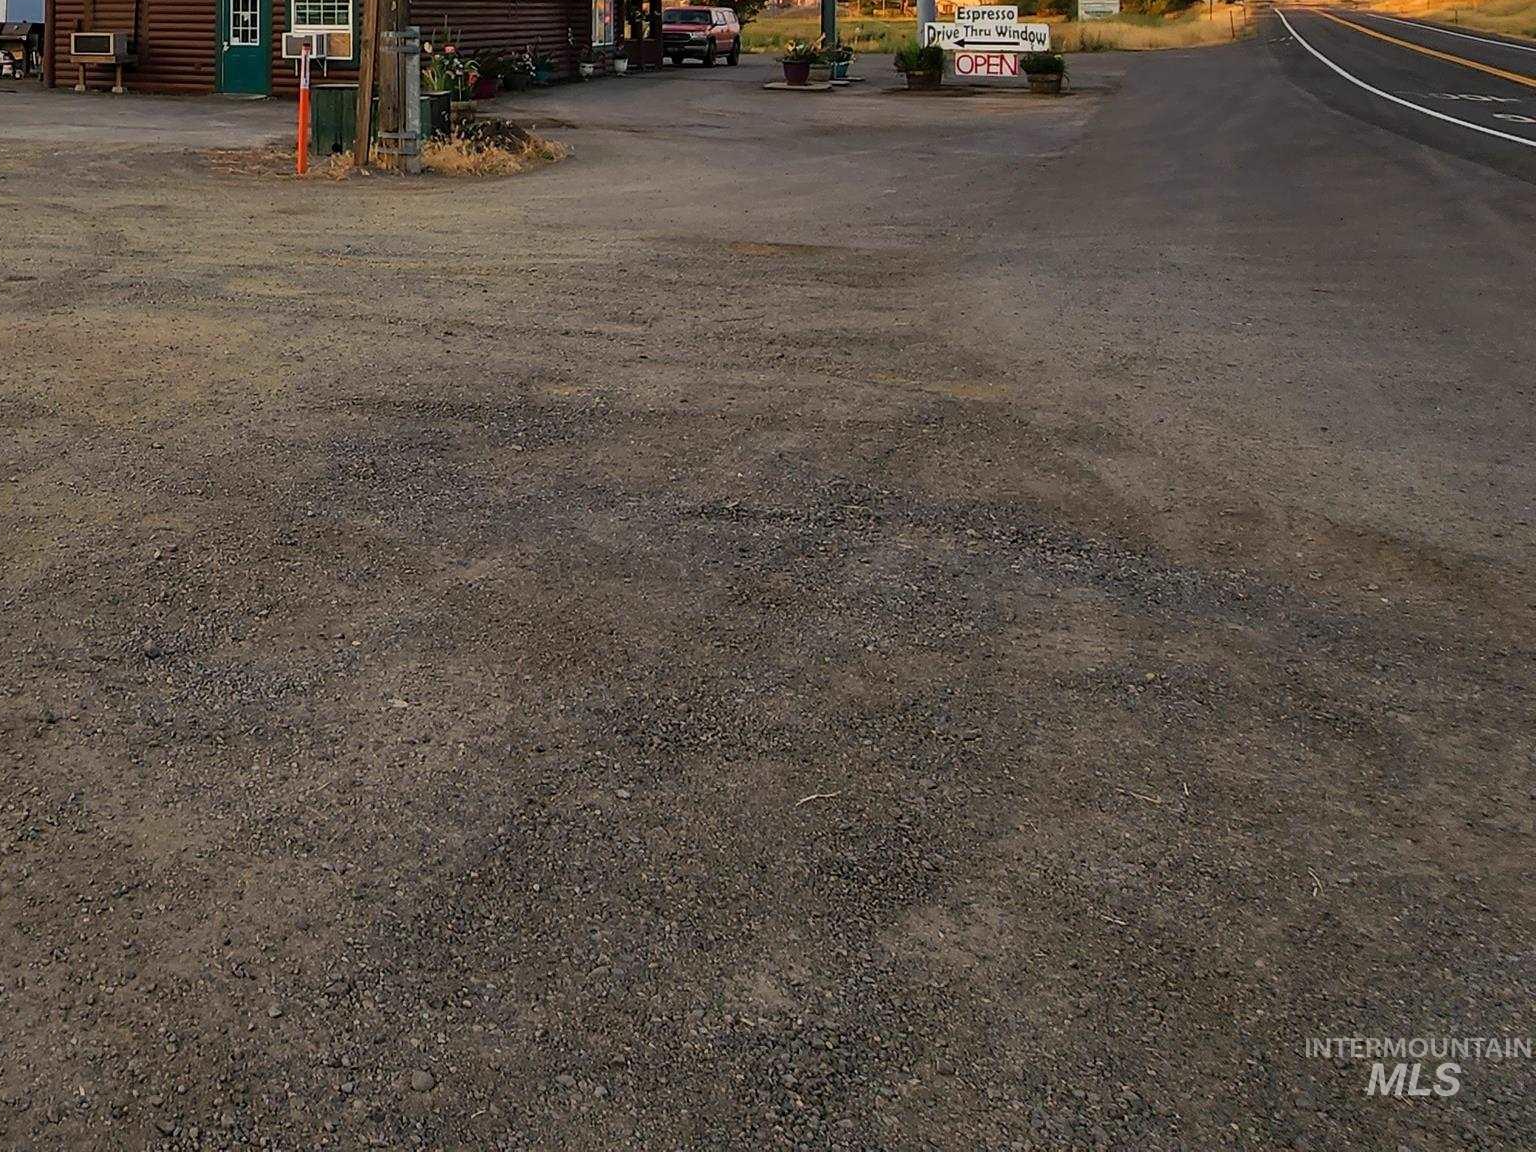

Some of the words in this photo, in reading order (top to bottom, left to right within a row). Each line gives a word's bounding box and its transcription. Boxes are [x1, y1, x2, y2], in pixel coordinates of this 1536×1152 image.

[957, 6, 1015, 22] Espresso
[927, 25, 960, 45] Drive
[964, 25, 991, 37] Thru
[995, 25, 1046, 46] Window
[956, 54, 1019, 75] OPEN
